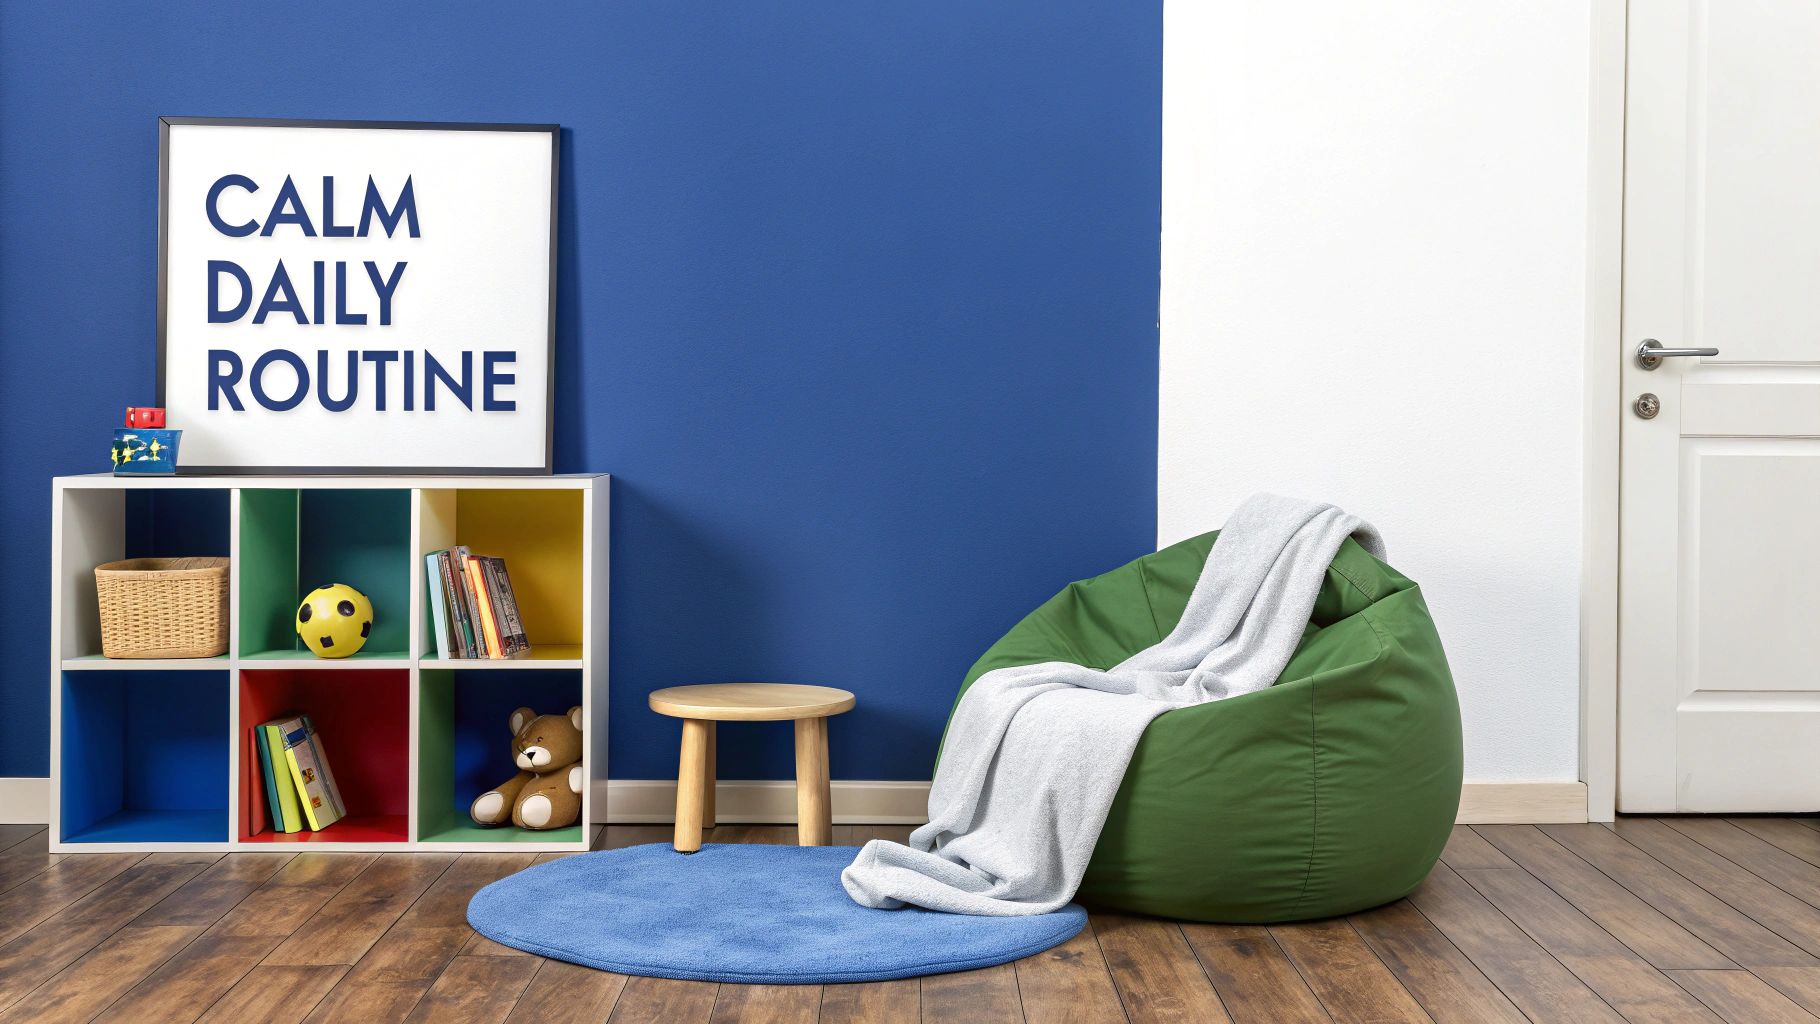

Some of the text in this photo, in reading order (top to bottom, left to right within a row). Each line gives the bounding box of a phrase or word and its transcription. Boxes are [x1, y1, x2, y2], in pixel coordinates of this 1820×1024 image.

[205, 173, 421, 239] CALM
[207, 258, 409, 326] DAILY
[207, 348, 517, 413] ROUTINE
